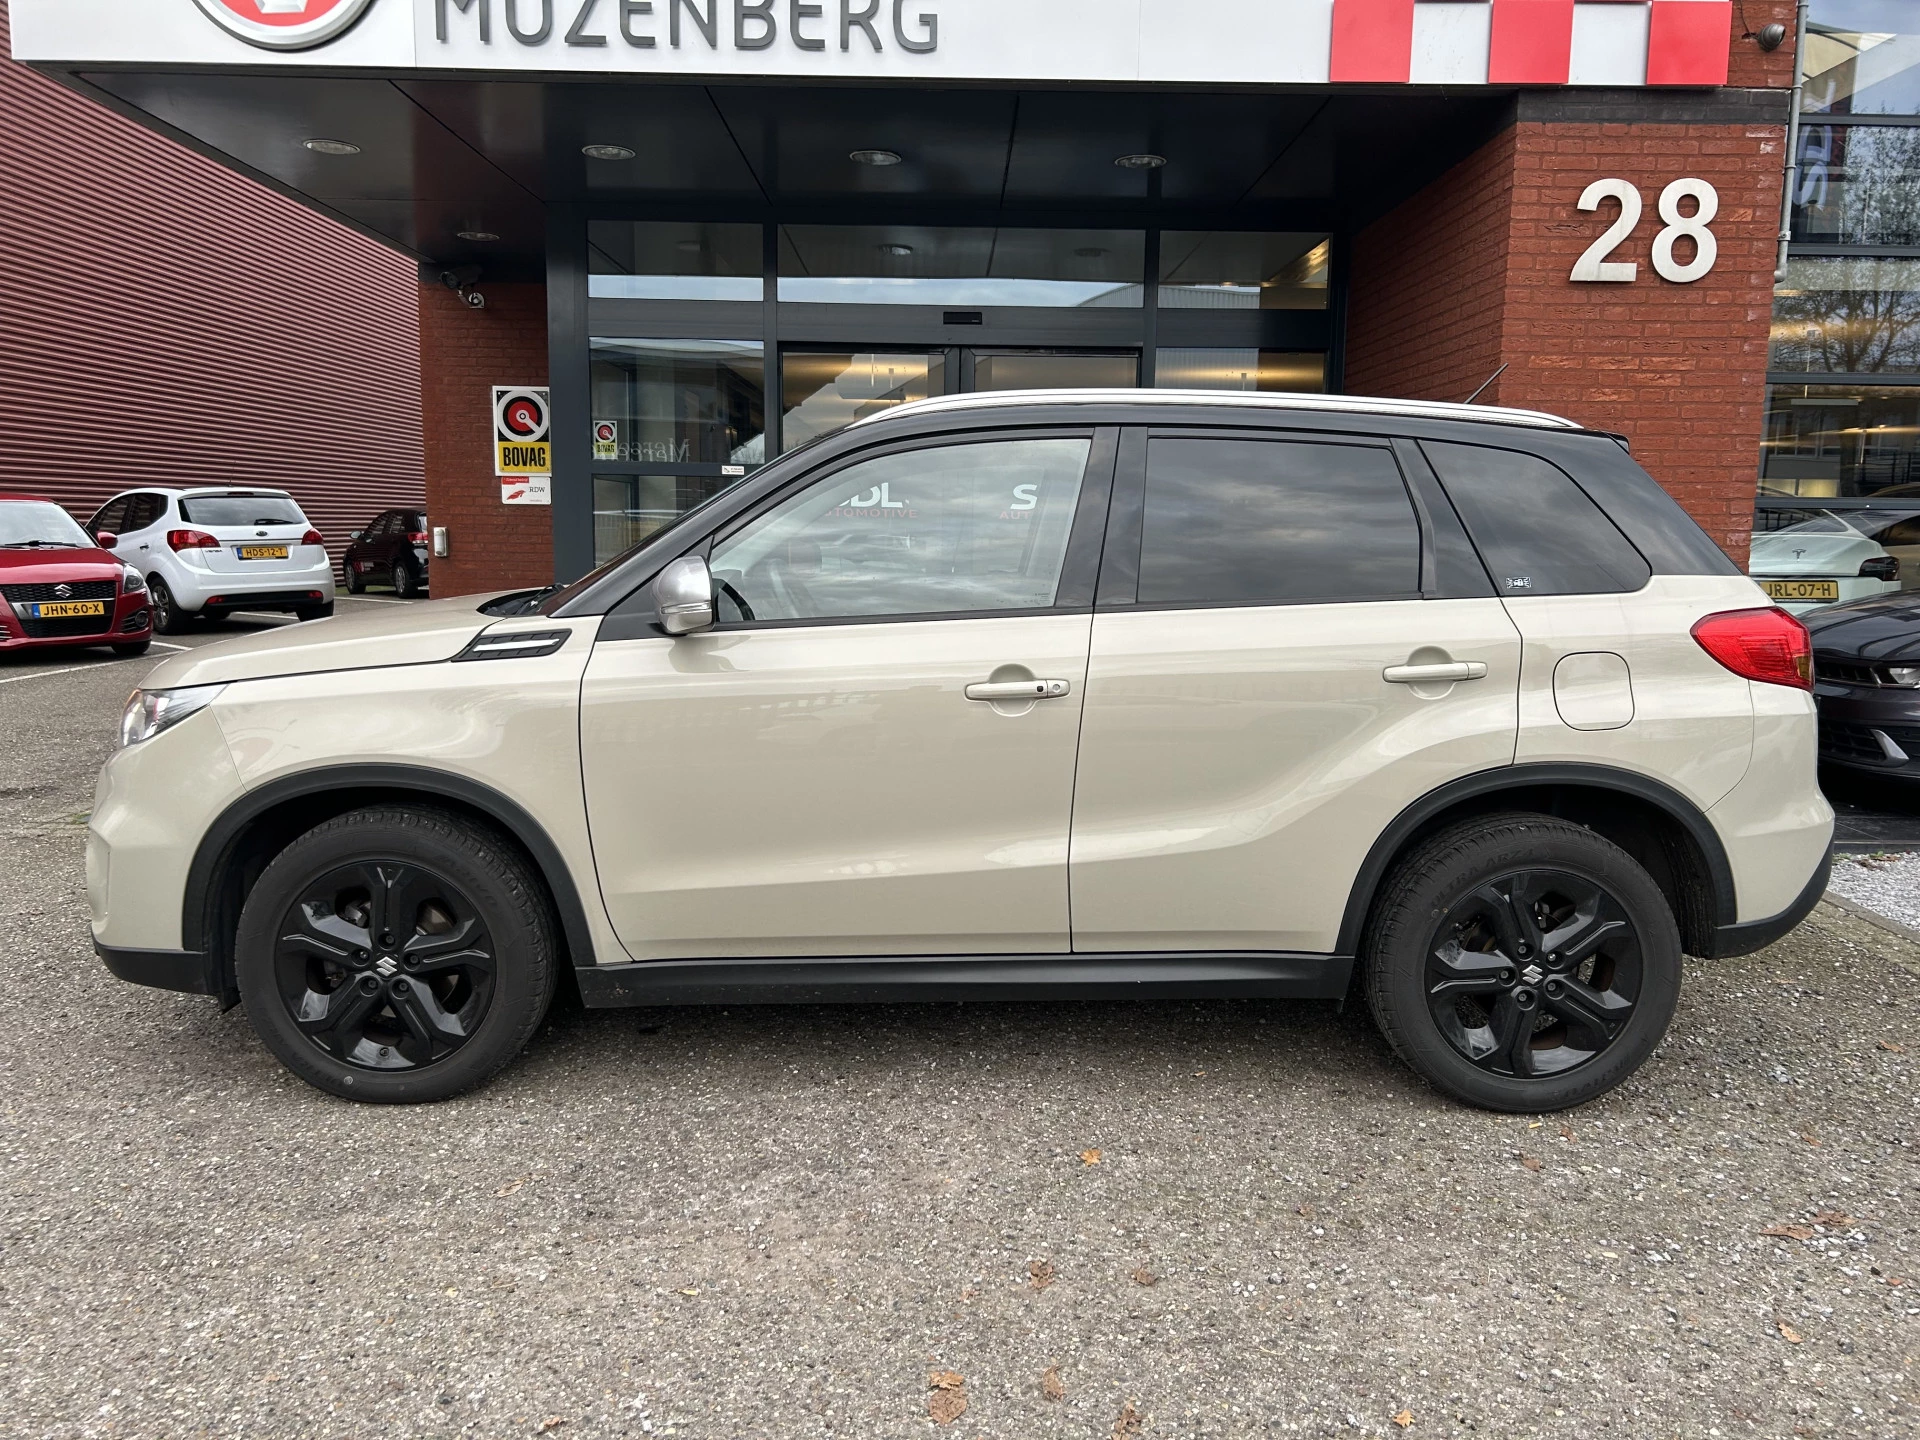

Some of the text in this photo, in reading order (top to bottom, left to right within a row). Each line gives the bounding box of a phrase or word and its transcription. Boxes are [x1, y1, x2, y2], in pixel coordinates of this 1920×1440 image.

[1569, 177, 1719, 283] 28
[502, 446, 547, 468] BOVAG
[245, 548, 284, 557] HDS-12-T
[1767, 583, 1831, 597] JRL-07-H
[43, 603, 101, 616] JHN-60-X
